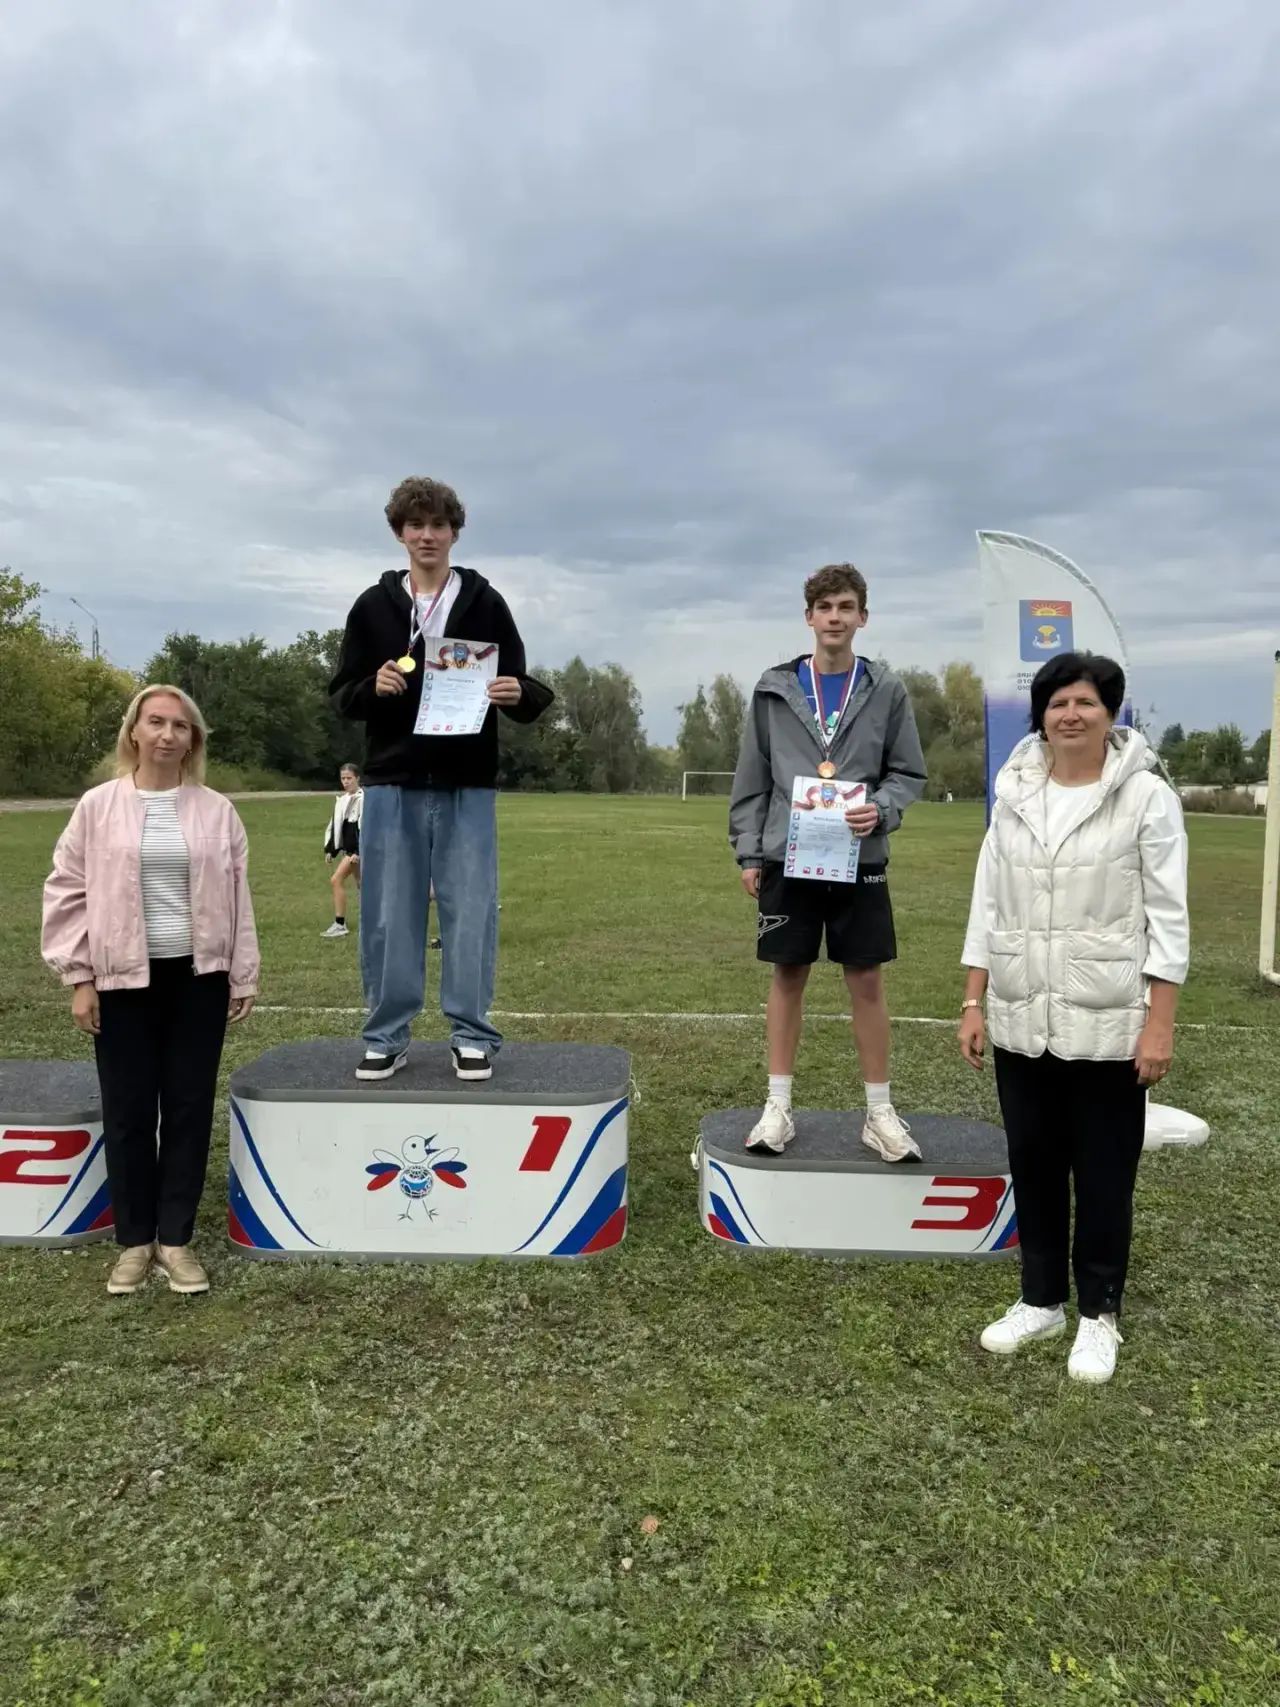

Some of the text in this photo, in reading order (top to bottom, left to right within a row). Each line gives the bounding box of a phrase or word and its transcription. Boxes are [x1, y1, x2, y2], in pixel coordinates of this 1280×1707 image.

[0, 1130, 91, 1184] 2
[519, 1116, 572, 1171] 1
[911, 1177, 1006, 1230] 3
